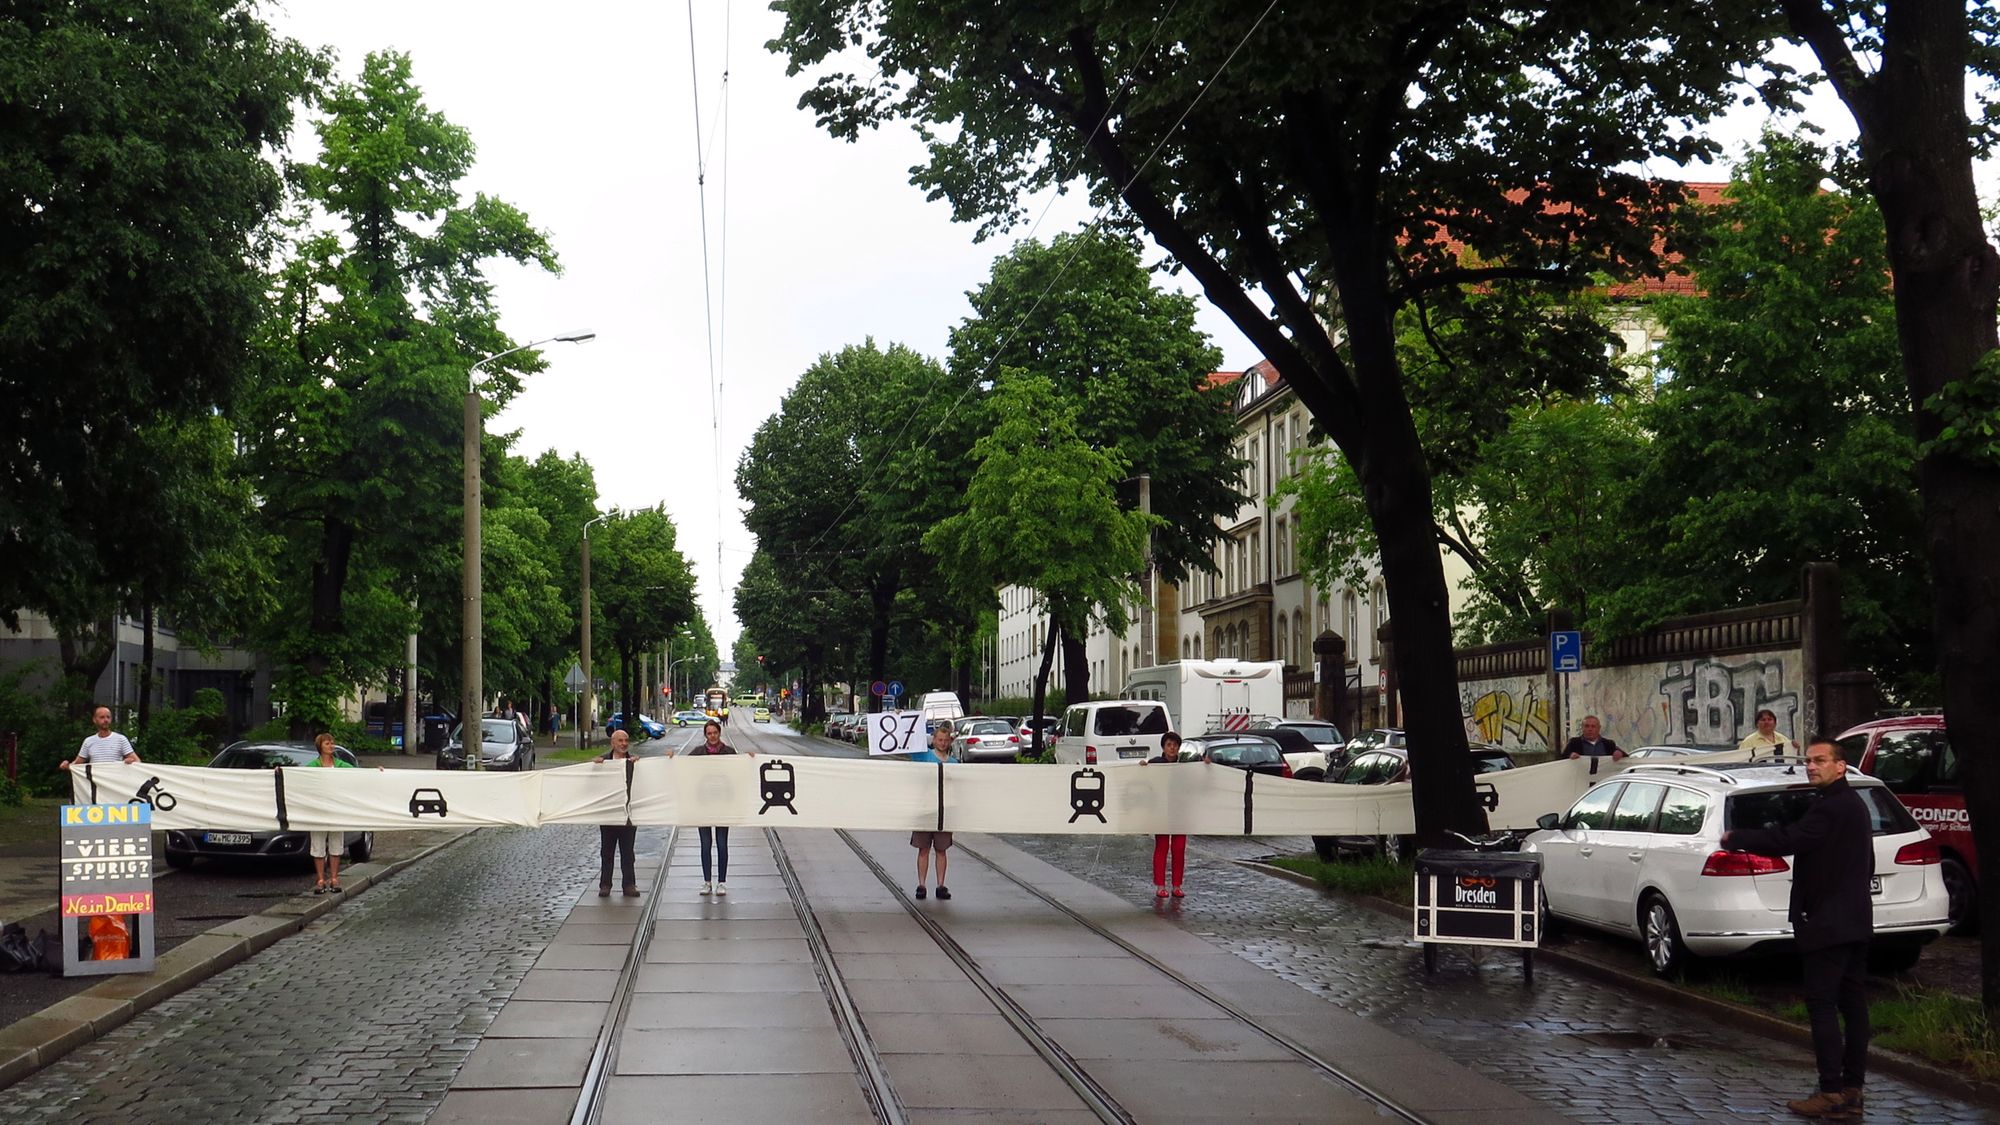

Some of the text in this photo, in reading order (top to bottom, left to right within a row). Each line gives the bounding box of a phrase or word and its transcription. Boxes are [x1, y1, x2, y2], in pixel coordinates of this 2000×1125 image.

[1556, 635, 1568, 650] P
[66, 805, 140, 824] KÖNI
[1912, 808, 1970, 822] CONDO
[73, 861, 149, 876] SPURIG?
[1455, 885, 1496, 904] Dresden
[66, 894, 150, 914] Nein Danke!
